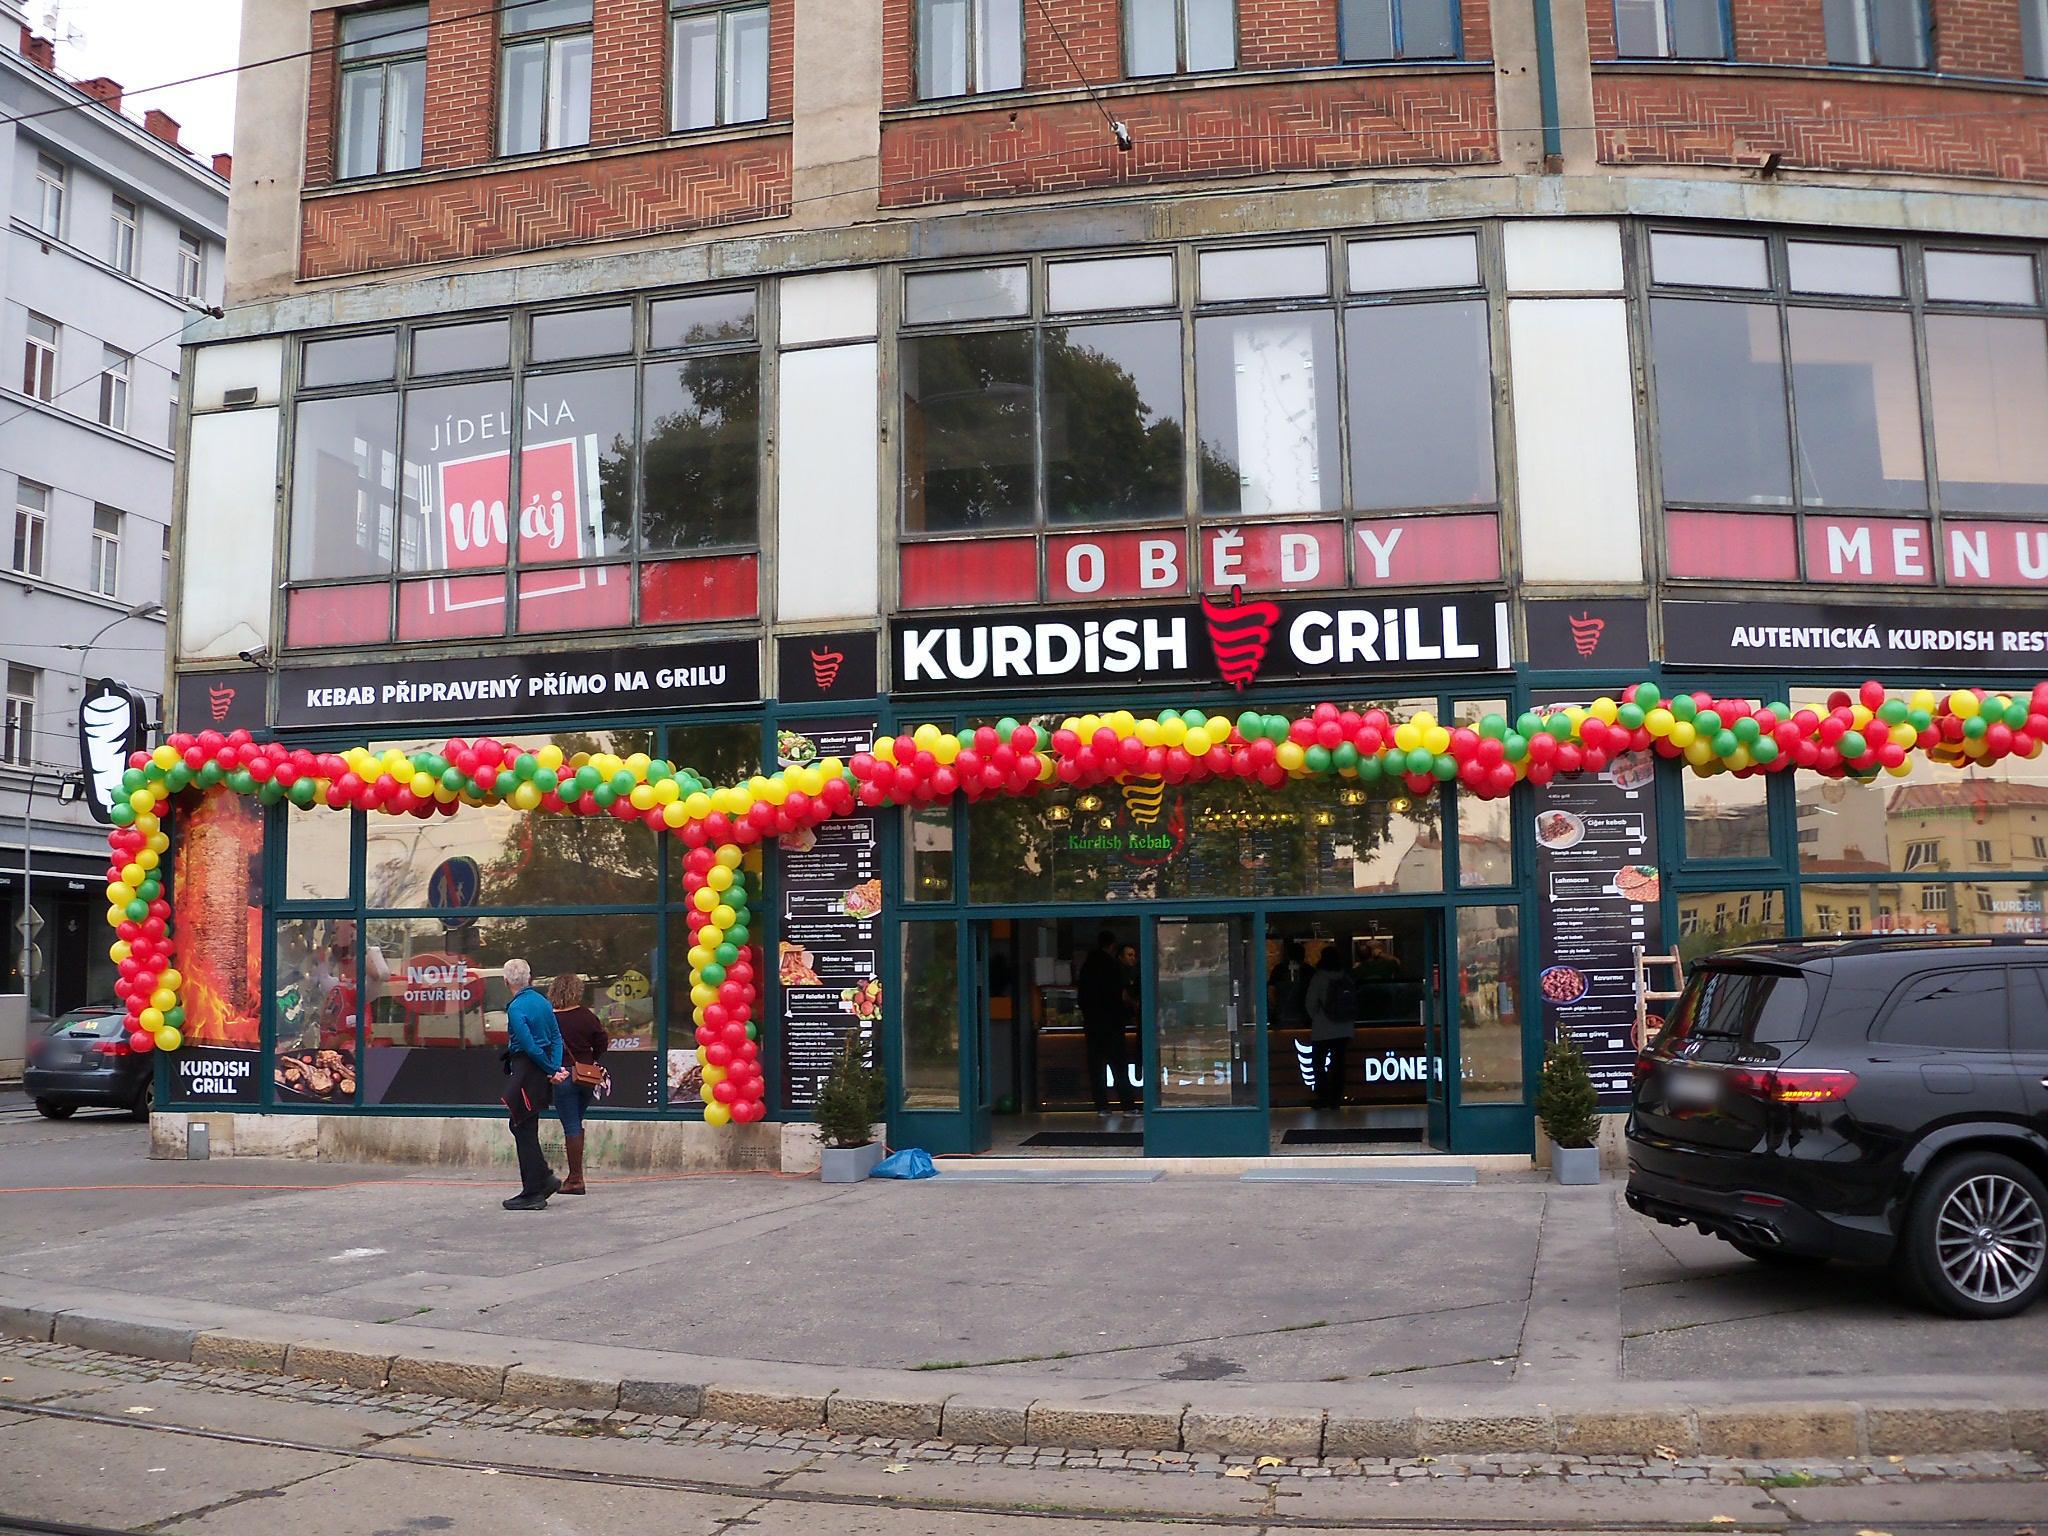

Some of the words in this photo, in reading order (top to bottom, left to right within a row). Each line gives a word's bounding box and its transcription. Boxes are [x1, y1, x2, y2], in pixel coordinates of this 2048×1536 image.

[430, 399, 575, 452] JÍDELNA
[1065, 527, 1404, 594] OBĚDY
[1826, 526, 2048, 581] MENU
[1730, 623, 1881, 650] AUTENTICKÁ
[1888, 629, 1994, 652] KURDISH
[306, 687, 376, 708] KEBAB
[381, 677, 521, 704] PŘIPRAVENÝ
[528, 672, 606, 697] PŘÍMO
[614, 672, 649, 691] NA
[655, 665, 726, 689] GRILU
[1068, 834, 1122, 850] Kurdish
[1128, 834, 1171, 850] Kebab
[1992, 900, 2041, 912] KURDISH
[2004, 918, 2042, 933] AKCE
[407, 959, 469, 984] NOVĚ
[403, 986, 471, 1003] OTEVŘENO
[610, 1037, 640, 1048] 2025
